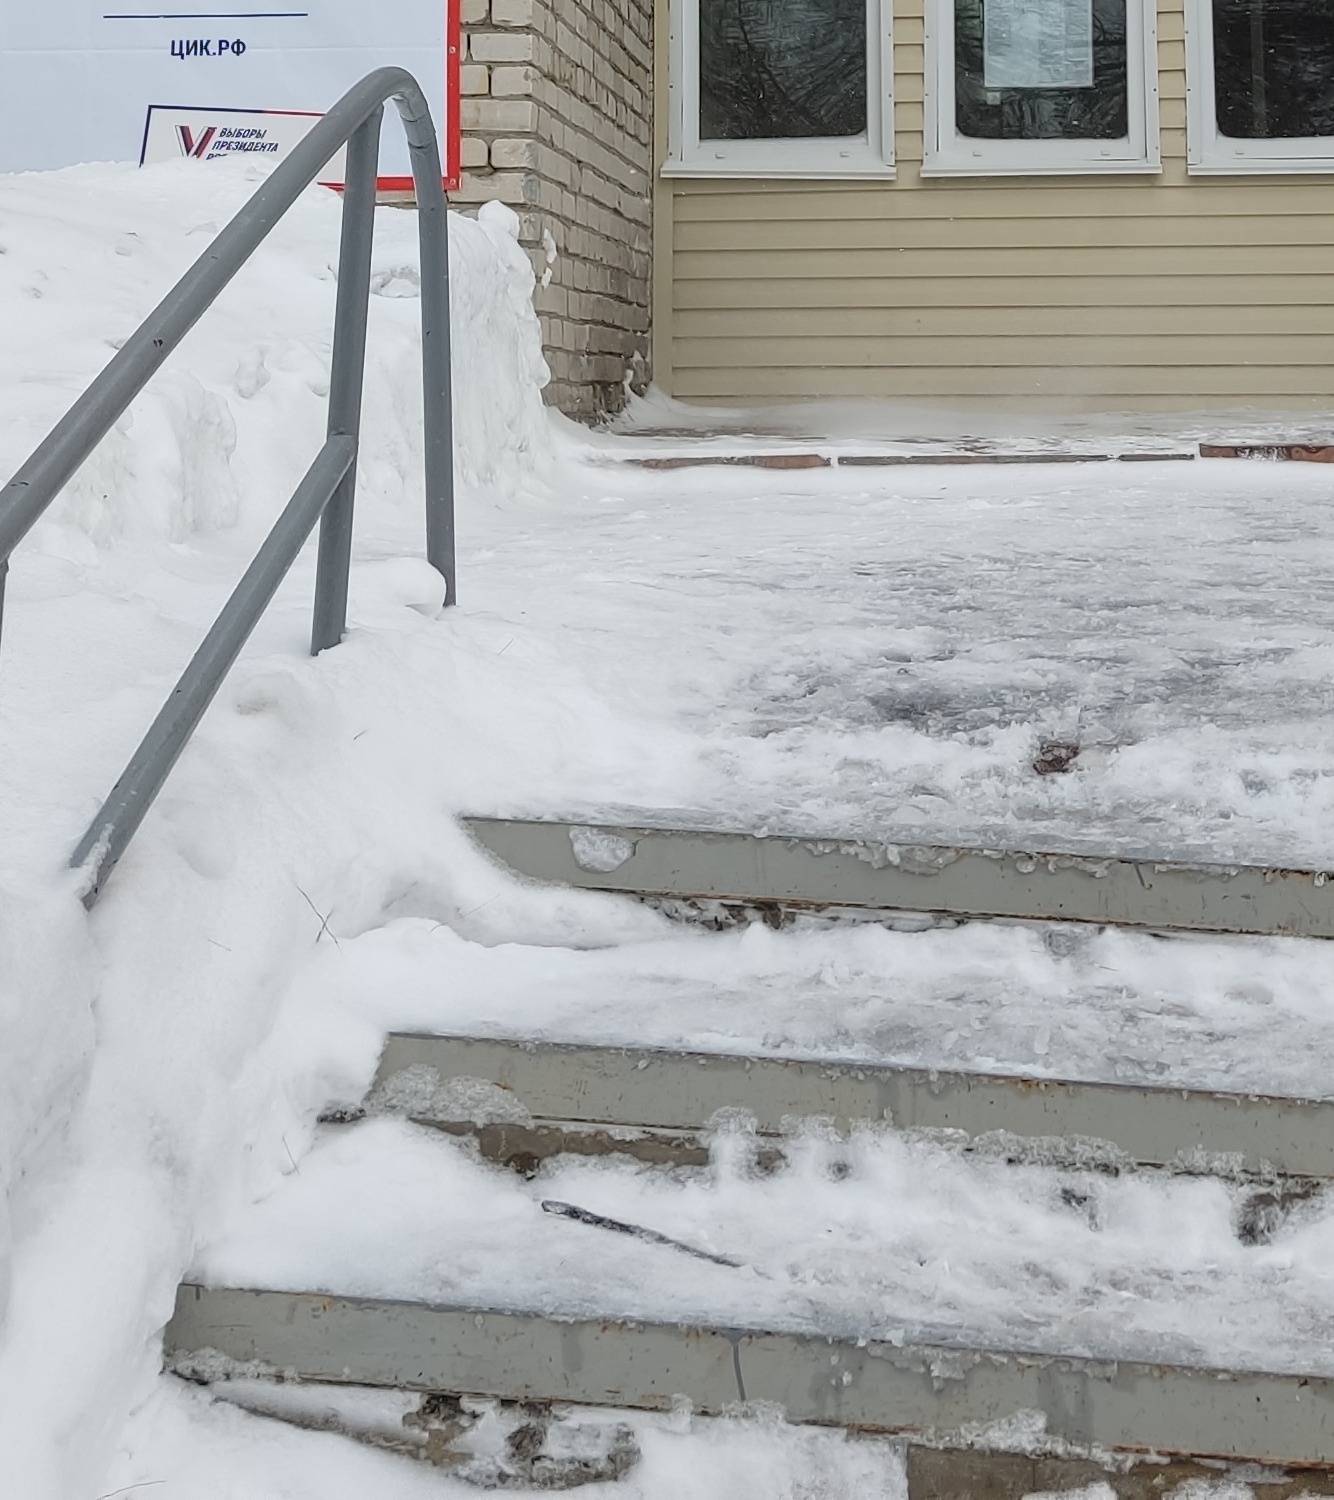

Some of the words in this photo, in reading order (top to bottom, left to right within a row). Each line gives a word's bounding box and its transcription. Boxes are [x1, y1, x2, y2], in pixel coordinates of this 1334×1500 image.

[170, 38, 247, 60] ЦИК.РФ
[219, 127, 267, 139] ВЫБОРЫ
[212, 140, 279, 152] ПРЕЗИДЕНТА
